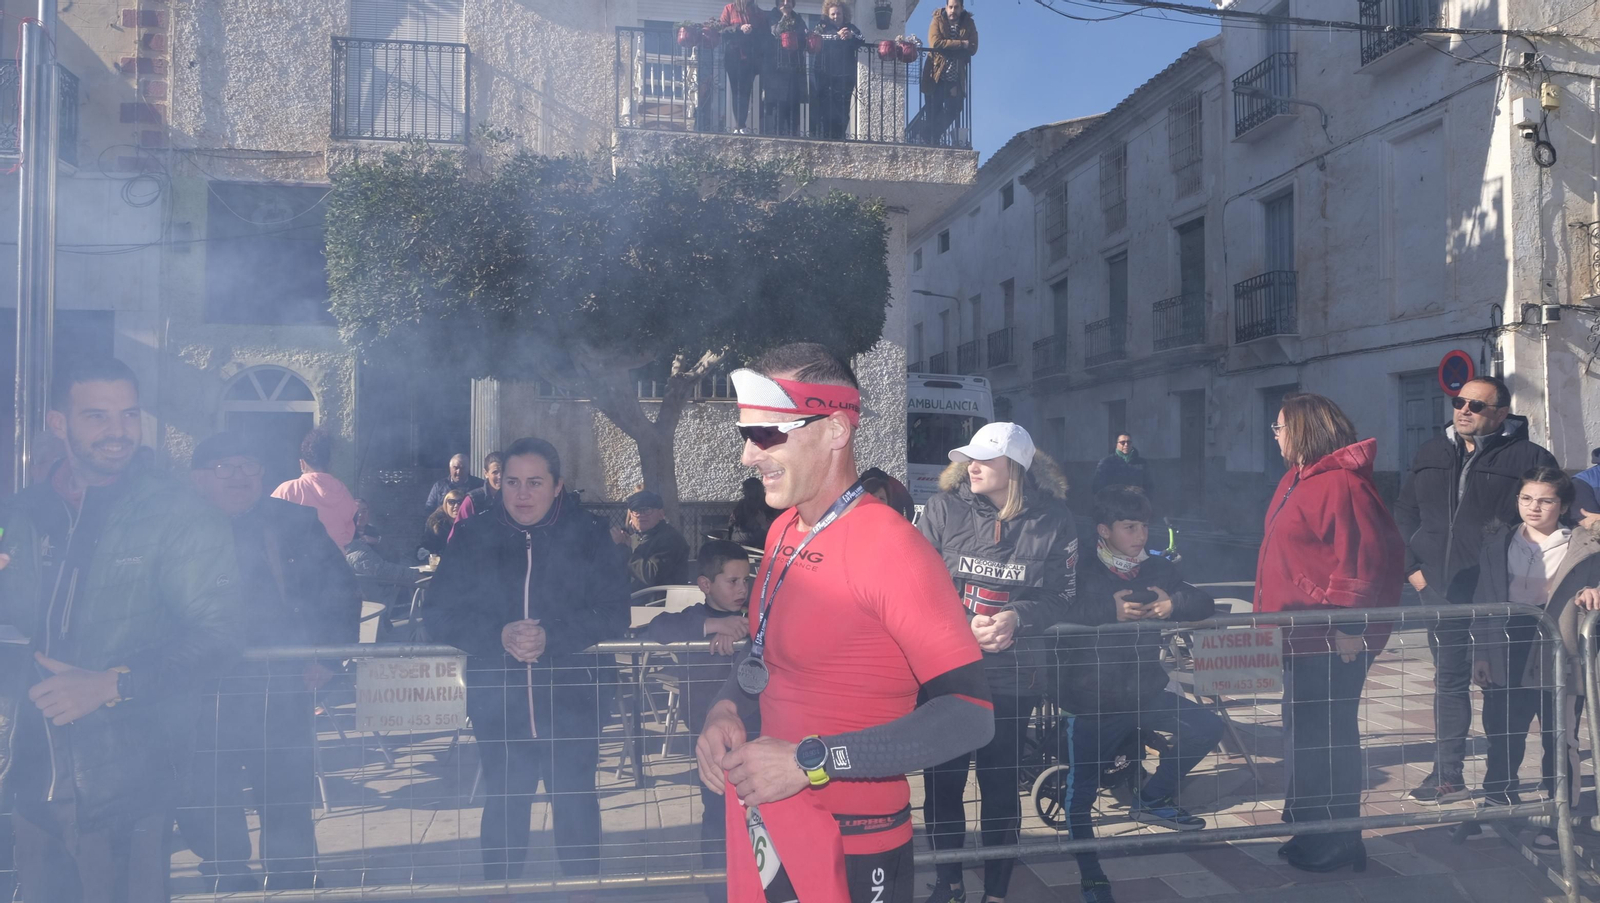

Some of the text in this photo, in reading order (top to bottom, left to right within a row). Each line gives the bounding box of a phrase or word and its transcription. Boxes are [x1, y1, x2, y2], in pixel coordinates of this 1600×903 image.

[907, 398, 979, 412] AMBULANCIA
[960, 557, 1021, 580] NORWAY
[1201, 631, 1274, 650] ALYSER DE
[368, 662, 457, 680] ALYSER DE
[1194, 653, 1279, 672] MAQUINARIA
[1256, 678, 1275, 689] 550
[360, 686, 465, 704] MAQUINARIA
[380, 715, 403, 727] 950
[407, 714, 431, 726] 453
[435, 713, 458, 726] 550
